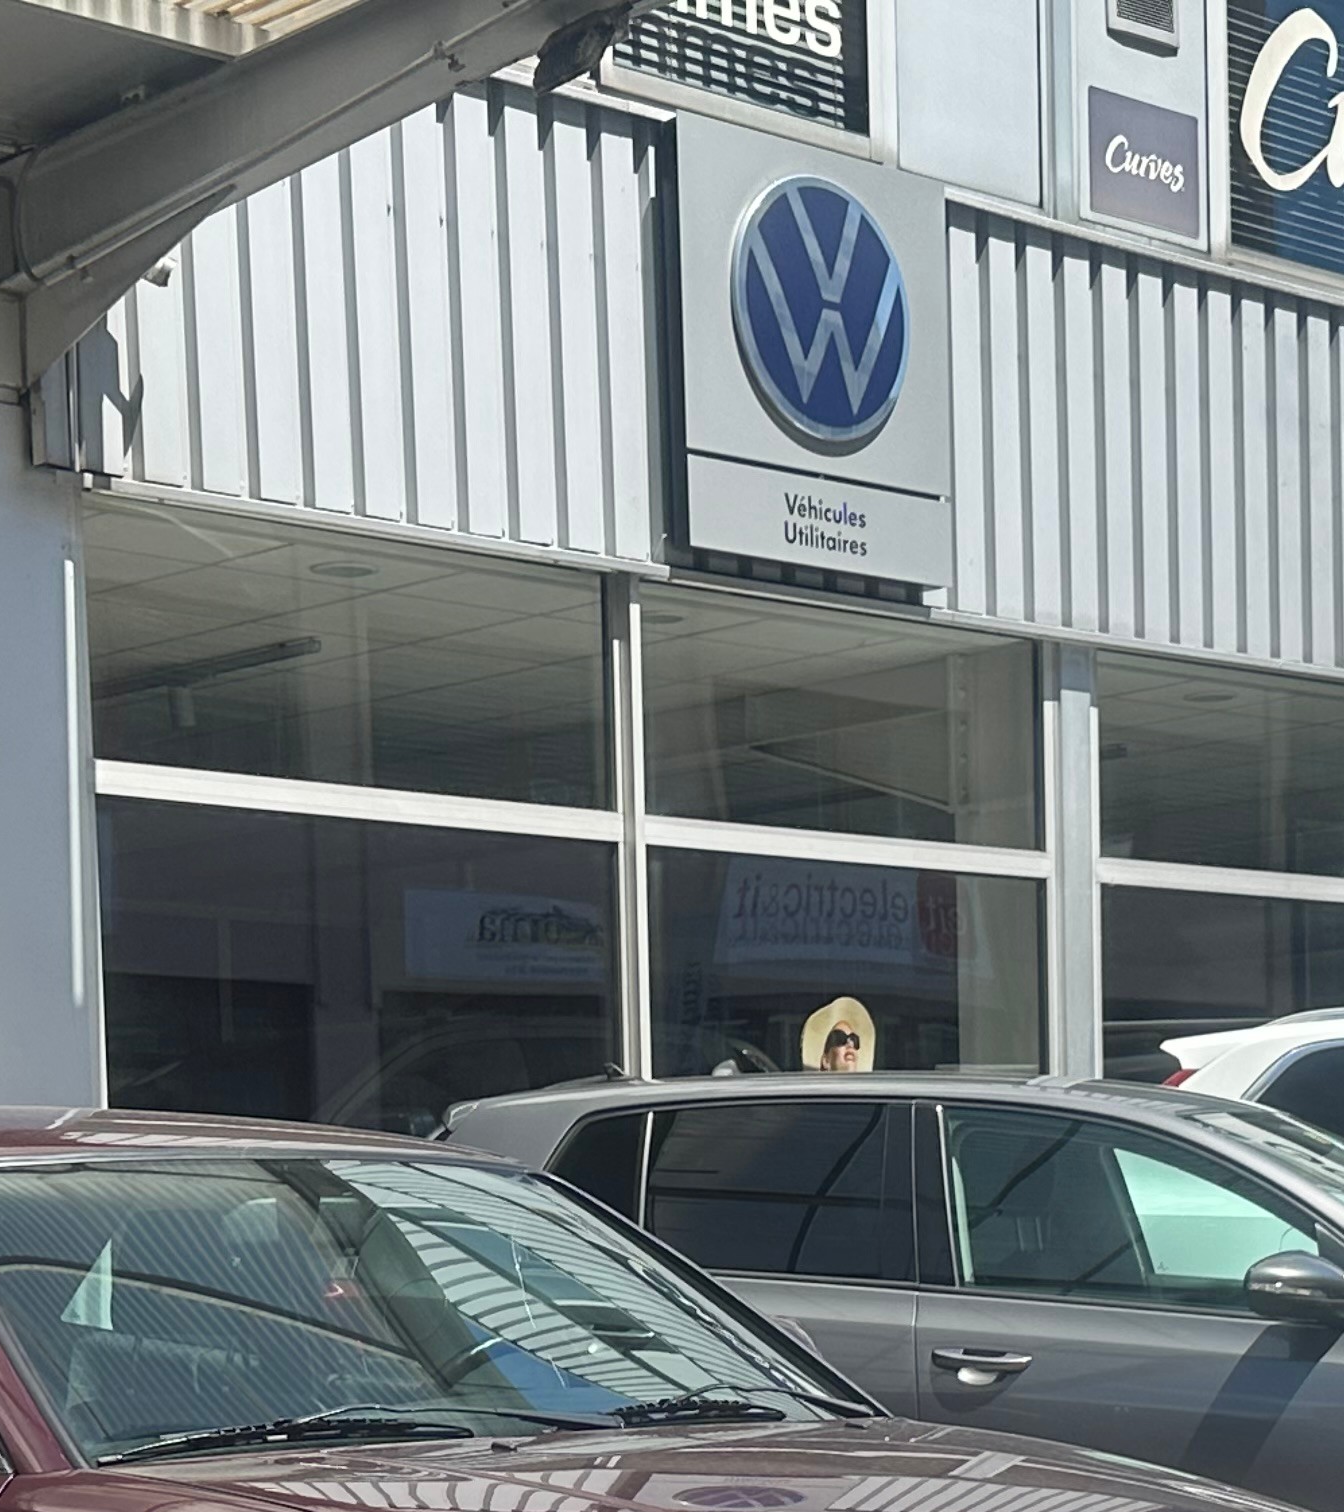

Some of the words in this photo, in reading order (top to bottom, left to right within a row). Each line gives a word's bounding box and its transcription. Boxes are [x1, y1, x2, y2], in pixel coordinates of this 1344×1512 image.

[1104, 135, 1186, 193] Curves
[784, 493, 867, 530] Véhicules
[784, 522, 868, 558] Utilitaires
